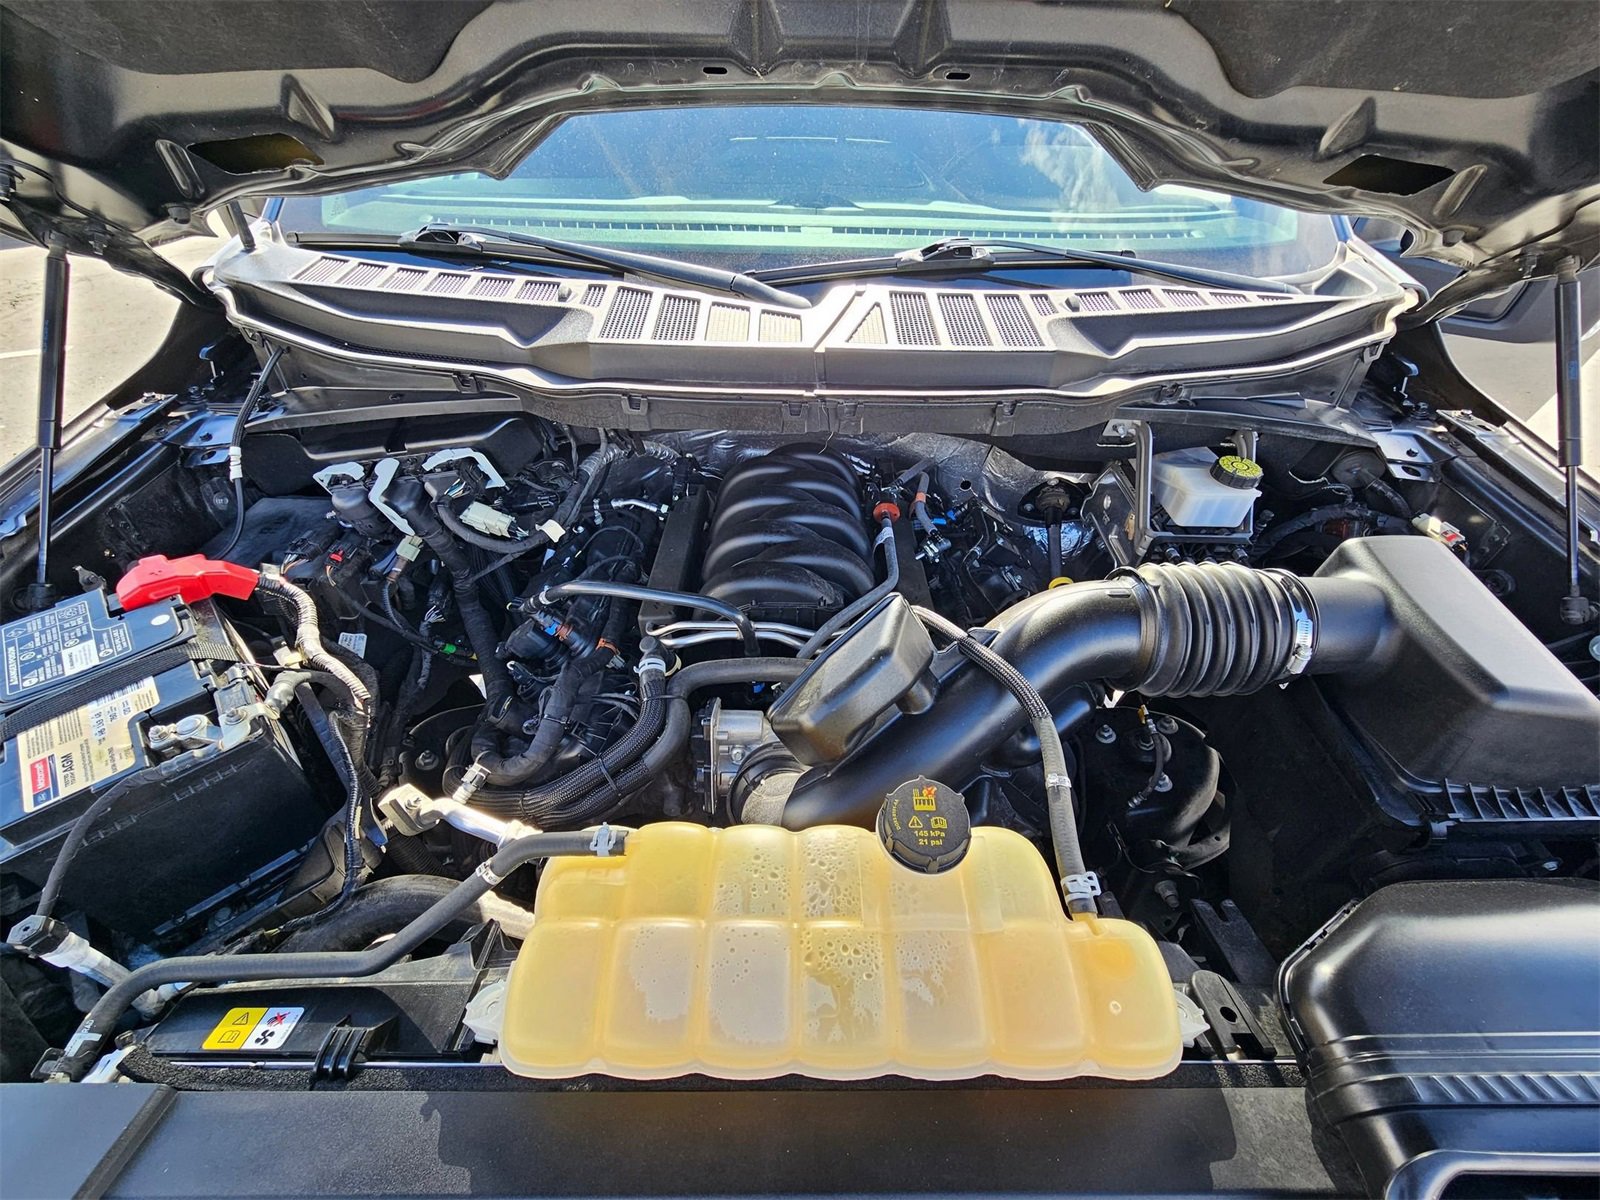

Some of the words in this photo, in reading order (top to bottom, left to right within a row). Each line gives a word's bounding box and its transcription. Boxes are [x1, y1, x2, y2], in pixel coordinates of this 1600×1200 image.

[61, 752, 75, 773] AGM
[914, 830, 929, 838] 145
[930, 830, 946, 838] kPa
[930, 839, 943, 847] psi
